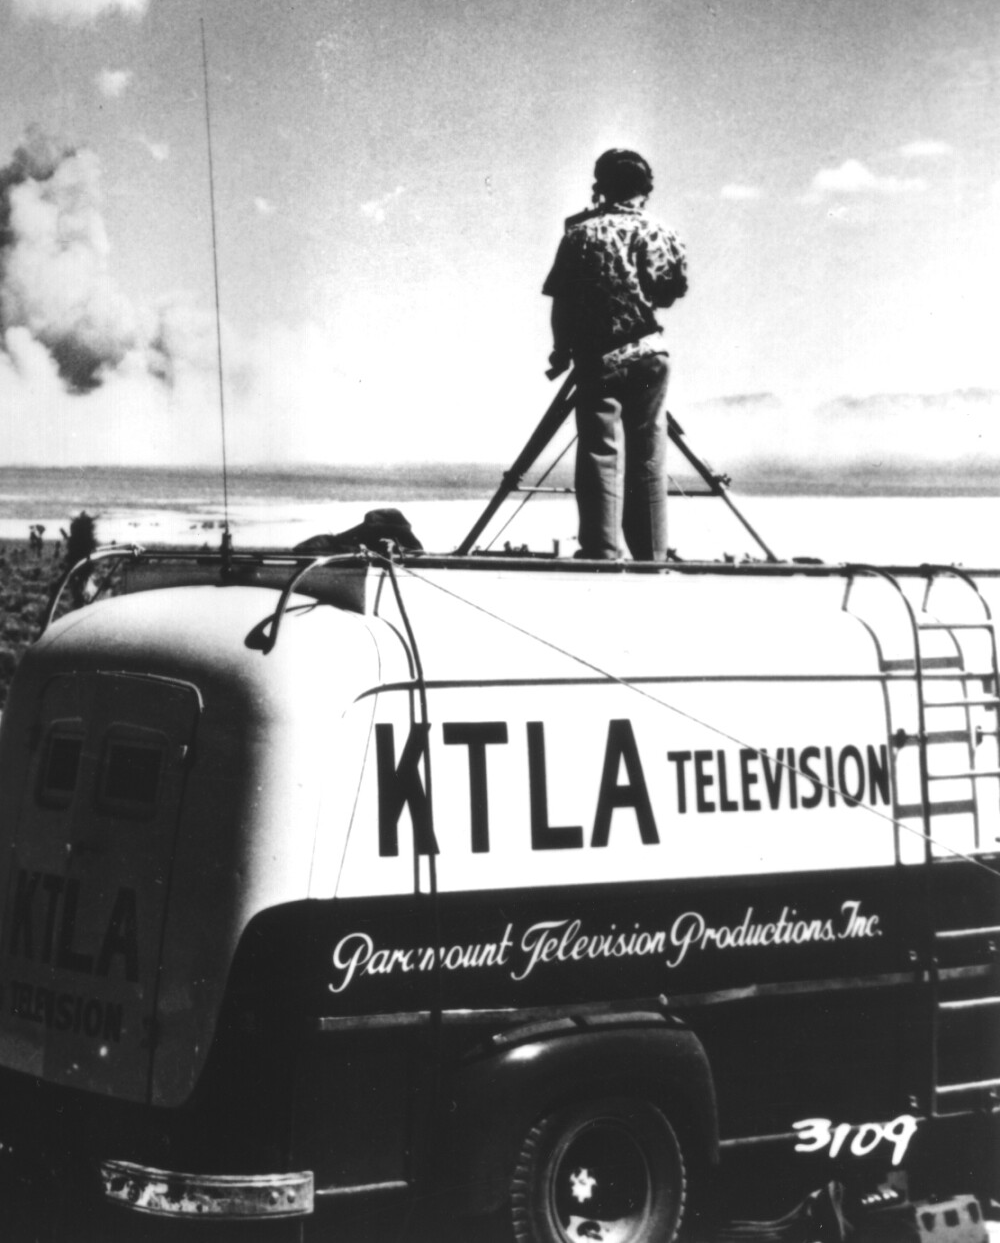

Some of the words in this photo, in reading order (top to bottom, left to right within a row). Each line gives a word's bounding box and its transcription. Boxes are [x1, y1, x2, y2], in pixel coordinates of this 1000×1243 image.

[375, 719, 660, 856] KTLA
[667, 744, 891, 814] TELEVISION
[9, 868, 139, 983] KTLA
[328, 922, 514, 994] Paramount
[510, 918, 666, 981] Television
[837, 899, 883, 940] Inc.
